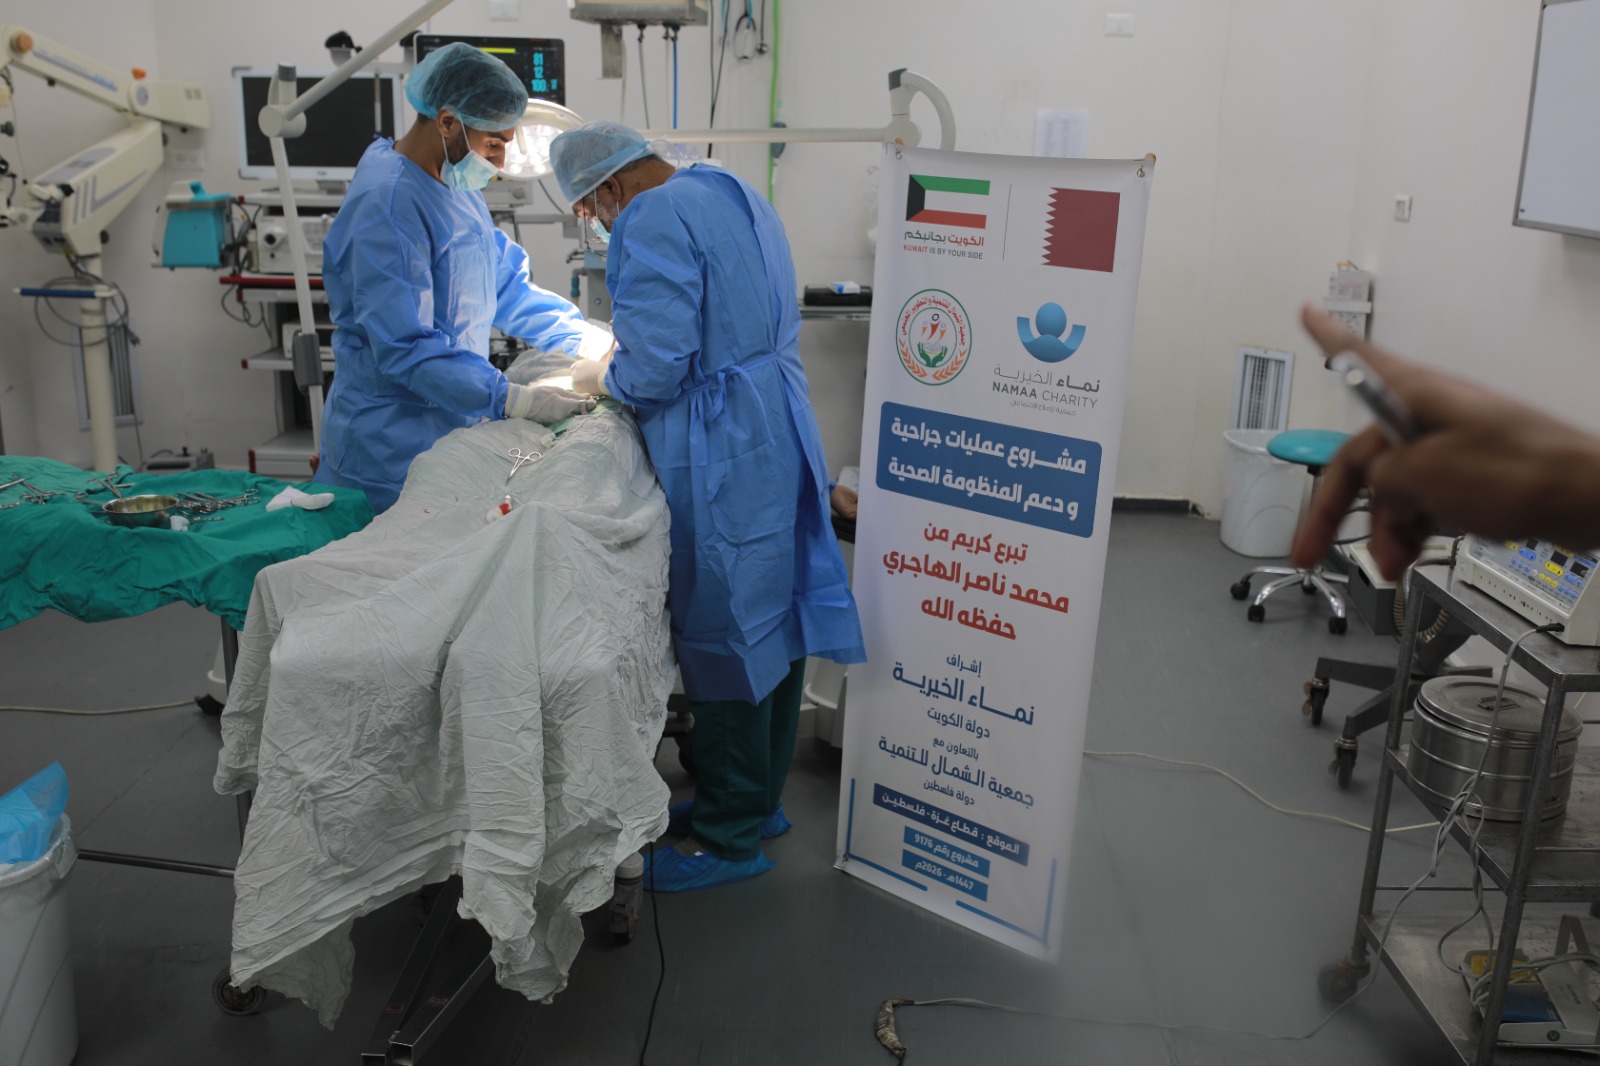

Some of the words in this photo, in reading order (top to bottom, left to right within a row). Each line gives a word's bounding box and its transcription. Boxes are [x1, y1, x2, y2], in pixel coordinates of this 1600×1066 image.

[531, 79, 547, 92] 100
[904, 230, 946, 245] بجانبكم
[948, 234, 985, 247] الكويت
[903, 244, 928, 253] KUWAIT
[947, 249, 966, 258] YOUR
[967, 251, 983, 260] SIDE
[993, 363, 1053, 385] الخيرية
[1056, 375, 1100, 393] نماء
[992, 381, 1037, 399] NAMAA
[1042, 390, 1098, 409] CHARITY
[891, 417, 942, 448] جراحية
[945, 430, 1005, 458] عمليات
[888, 456, 941, 484] الصحية
[942, 468, 1022, 503] المنظومة
[924, 523, 950, 542] من
[952, 532, 993, 555] كريم
[993, 542, 1029, 565] تبرع
[882, 550, 961, 584] الهاجري
[962, 571, 1006, 596] ناصر
[921, 596, 954, 621] الله
[1009, 583, 1070, 614] محمد
[957, 607, 1017, 640] حفظه
[946, 654, 982, 678] إشراف
[892, 661, 965, 702] الخيرية
[967, 686, 1035, 726] نماء
[927, 707, 964, 729] الكويت
[965, 719, 991, 739] دولة
[878, 736, 929, 767] للتنمية
[933, 737, 945, 747] مع
[946, 743, 979, 762] بالتعاون
[931, 755, 986, 788] الشمال
[923, 779, 954, 797] فلسطين
[955, 791, 975, 806] دولة
[988, 776, 1034, 809] جمعية
[881, 792, 926, 817] فلسطين
[930, 810, 950, 826] غزة
[950, 820, 979, 838] قطاع
[914, 833, 933, 848] 9176
[933, 842, 950, 857] رقم
[986, 834, 1020, 855] الموقع
[950, 850, 979, 868] مشروع
